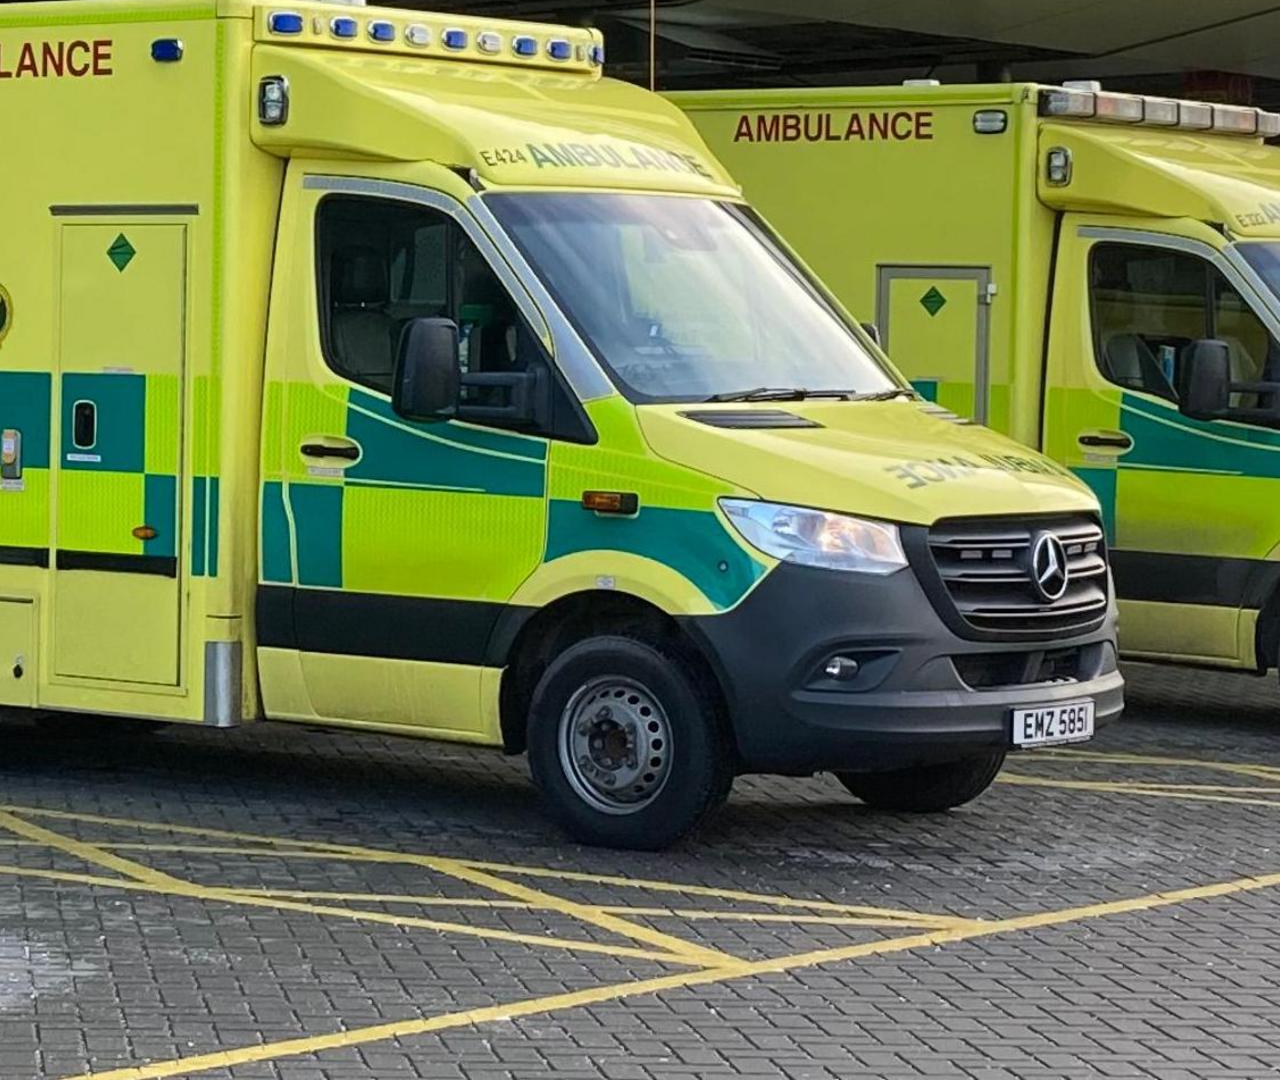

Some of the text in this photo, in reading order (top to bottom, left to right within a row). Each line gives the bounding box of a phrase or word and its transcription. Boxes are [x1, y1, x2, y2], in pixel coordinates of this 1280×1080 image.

[733, 111, 934, 142] AMBULANCE
[479, 143, 715, 181] E424 AMBULANCE
[1023, 707, 1088, 740] EMZ 5851
